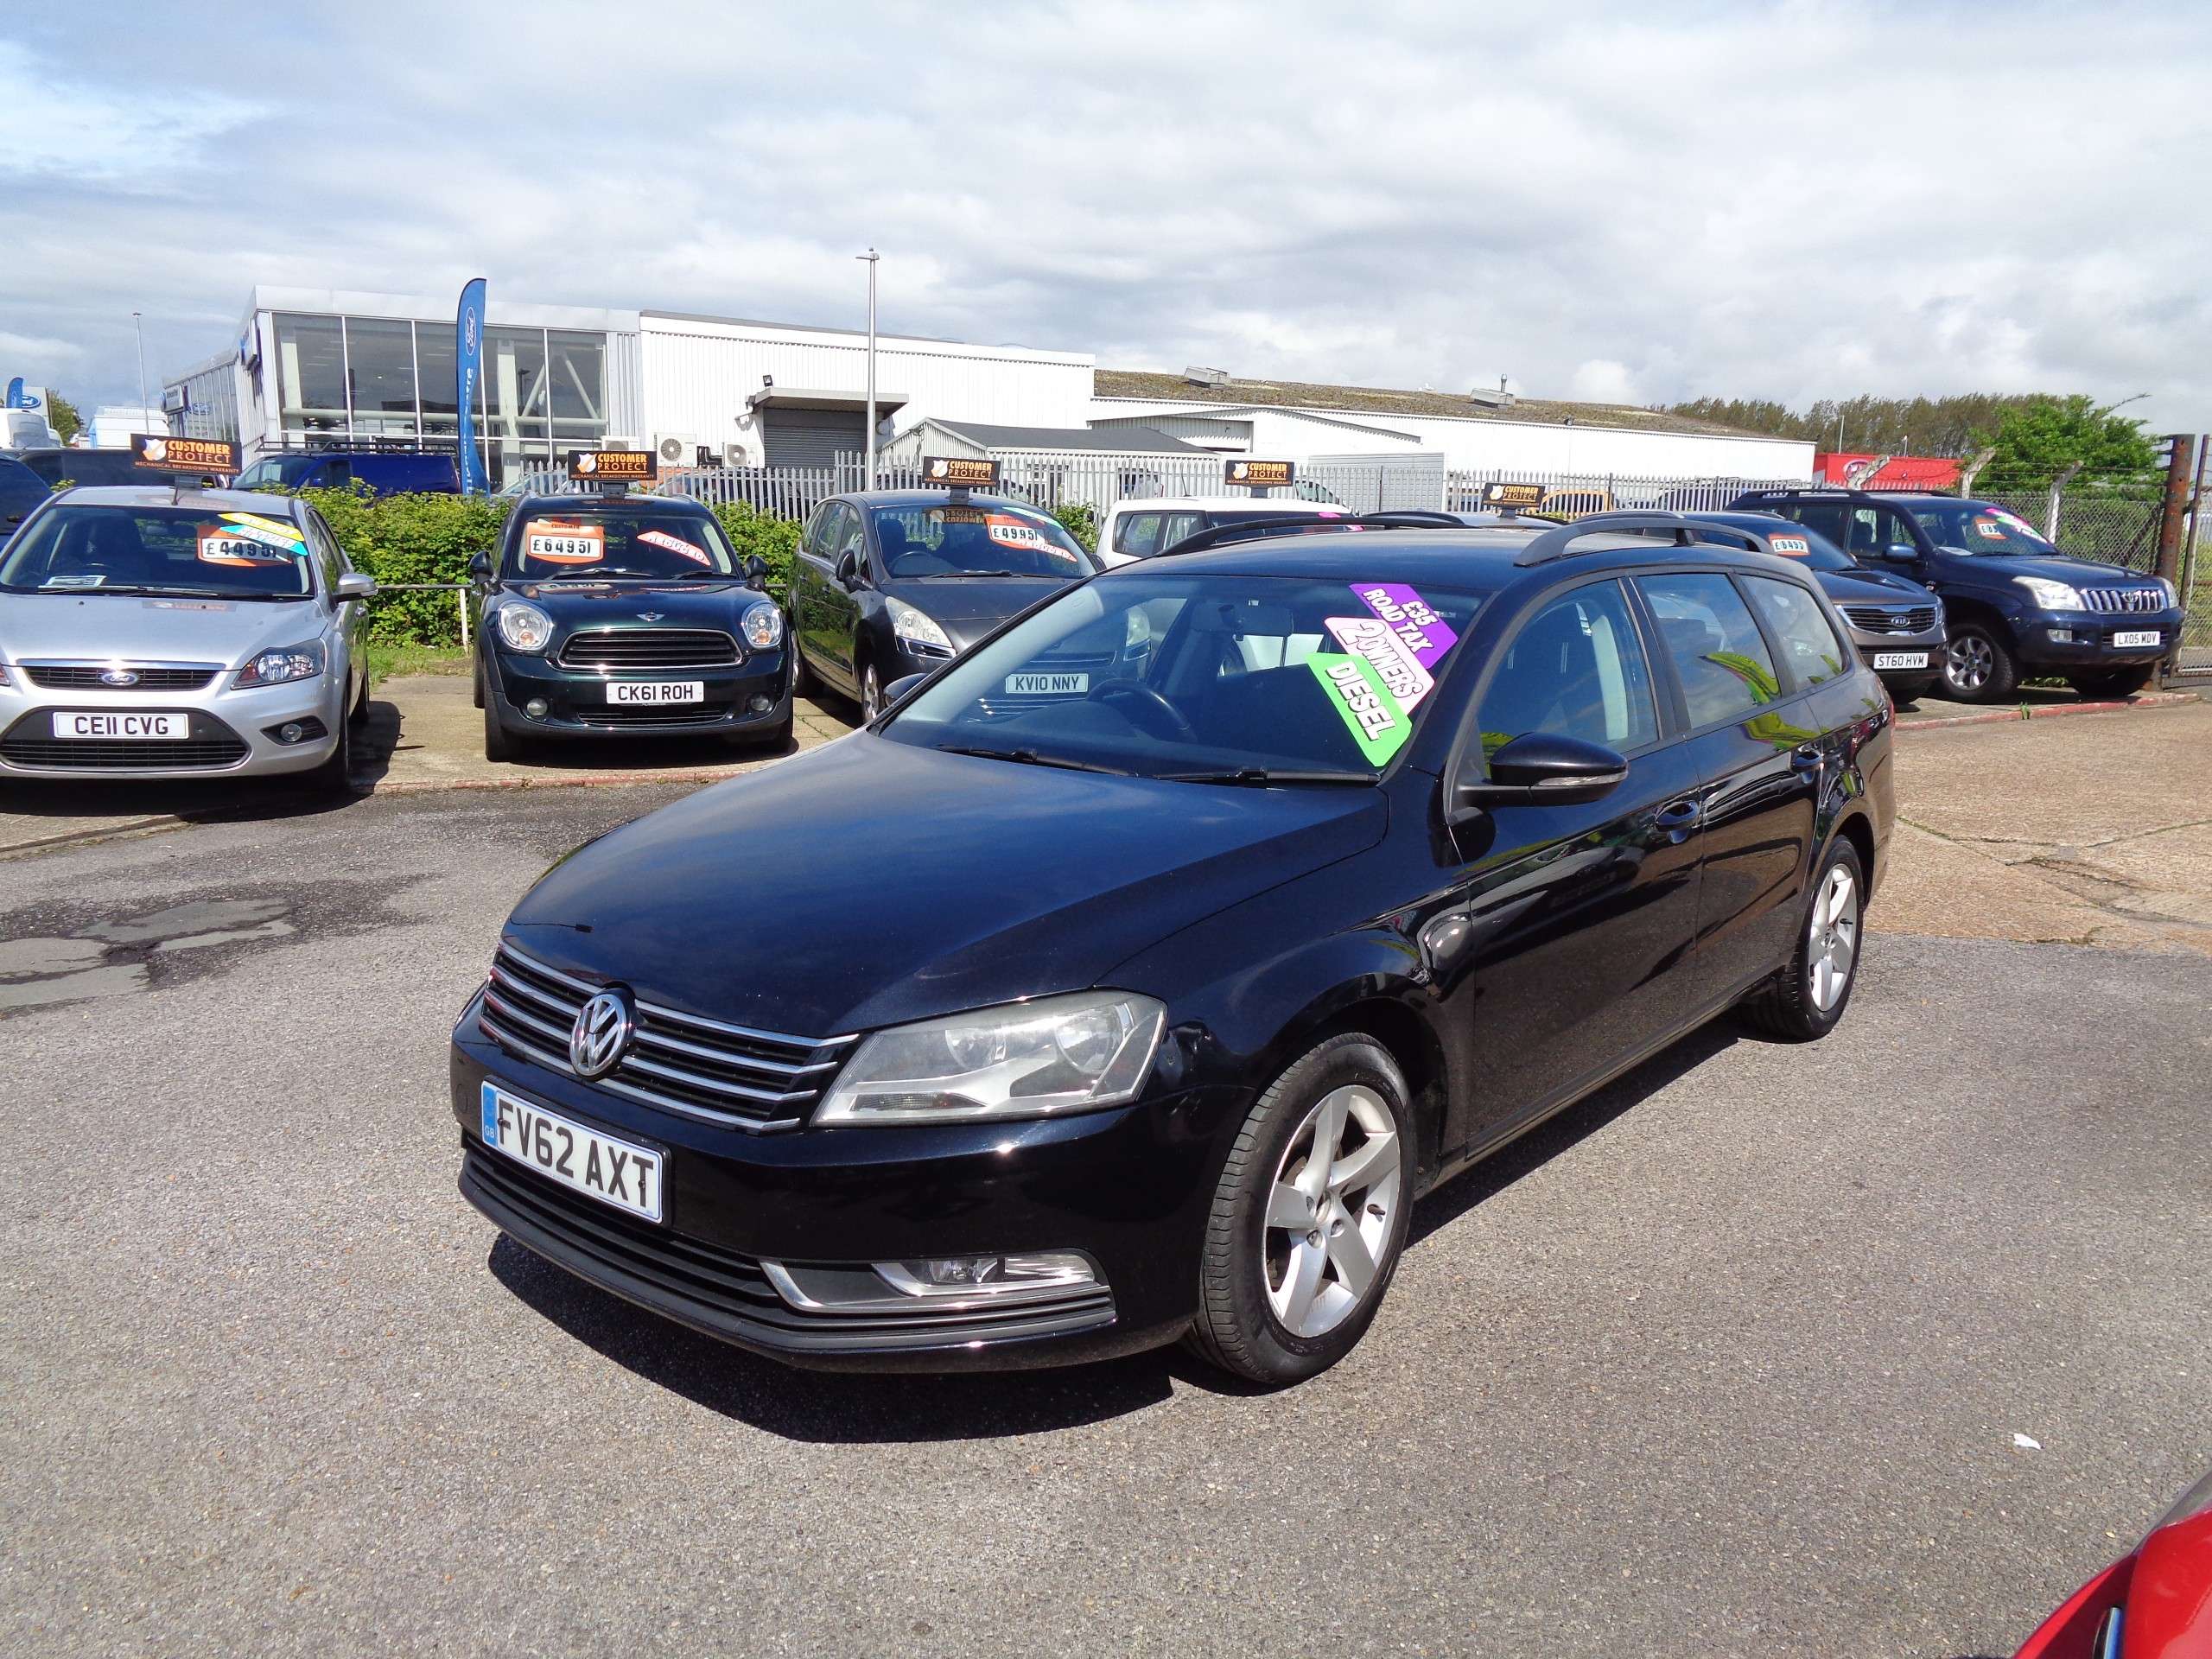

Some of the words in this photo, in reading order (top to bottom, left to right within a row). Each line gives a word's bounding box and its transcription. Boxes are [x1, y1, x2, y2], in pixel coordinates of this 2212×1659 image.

[168, 440, 231, 454] CUSTOMER
[168, 451, 231, 463] PROTECT
[598, 454, 647, 462] CUSTOMER
[950, 461, 992, 471] CUSTOMER
[949, 469, 991, 478] PROTECT
[1362, 588, 1407, 622] ROAD
[1395, 622, 1434, 653] TAX
[1402, 601, 1439, 626] £35
[2119, 634, 2139, 645] LX05
[2141, 633, 2157, 643] MDV
[1878, 656, 1904, 666] ST60
[1906, 656, 1924, 666] HVM
[1015, 677, 1047, 690] KV10
[1052, 676, 1079, 690] NNY
[618, 686, 656, 701] CK61
[661, 685, 693, 700] ROH
[1325, 661, 1396, 741] DIESEL
[74, 716, 118, 734] CE11
[124, 717, 168, 734] CVG
[485, 1125, 495, 1138] GB
[498, 1098, 574, 1179] FV62
[585, 1139, 654, 1208] AXT
